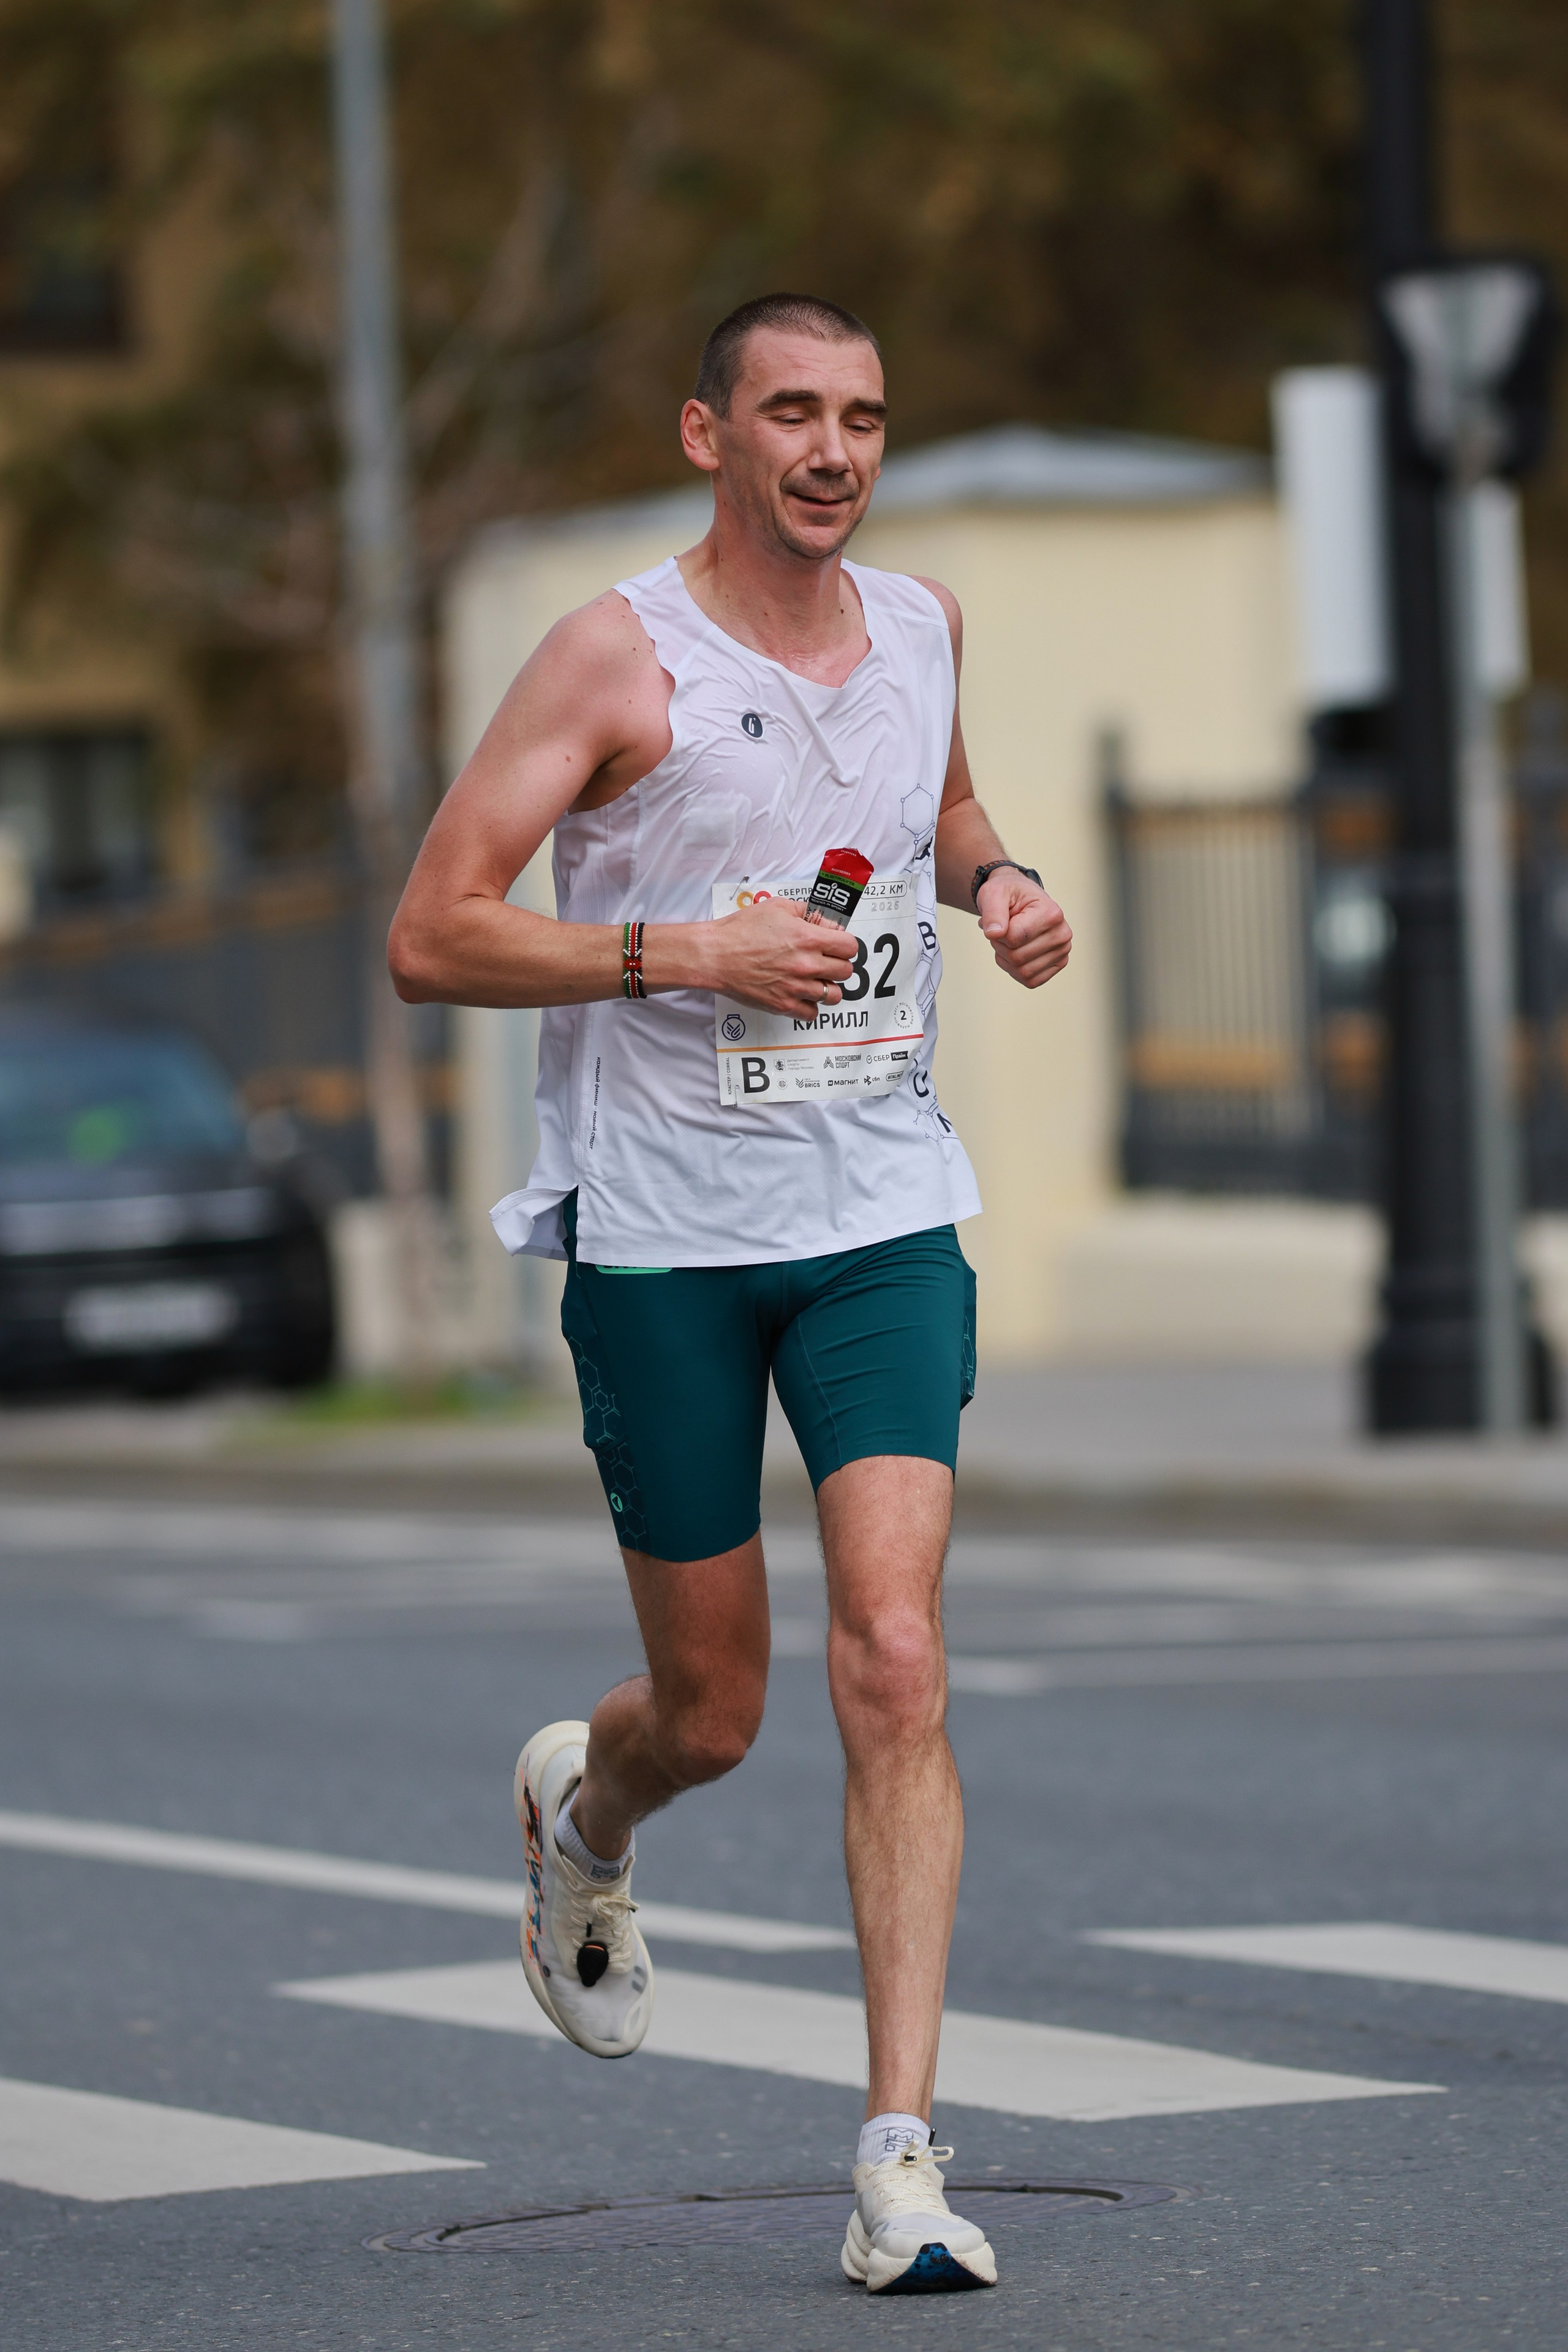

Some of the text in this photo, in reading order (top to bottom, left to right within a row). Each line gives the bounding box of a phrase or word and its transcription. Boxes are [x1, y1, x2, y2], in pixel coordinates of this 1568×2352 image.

[831, 868, 851, 876] RASPBERRY
[824, 873, 855, 886] ELECTROLYTE
[778, 888, 813, 896] СБЕРПР
[864, 886, 886, 896] 42,2
[872, 900, 900, 912] 2026
[804, 907, 812, 922] RGY
[835, 933, 900, 1001] 32
[900, 1010, 907, 1020] 2
[793, 1011, 869, 1031] КИРИЛЛ
[835, 1054, 862, 1062] МОСКОВСКИЙ
